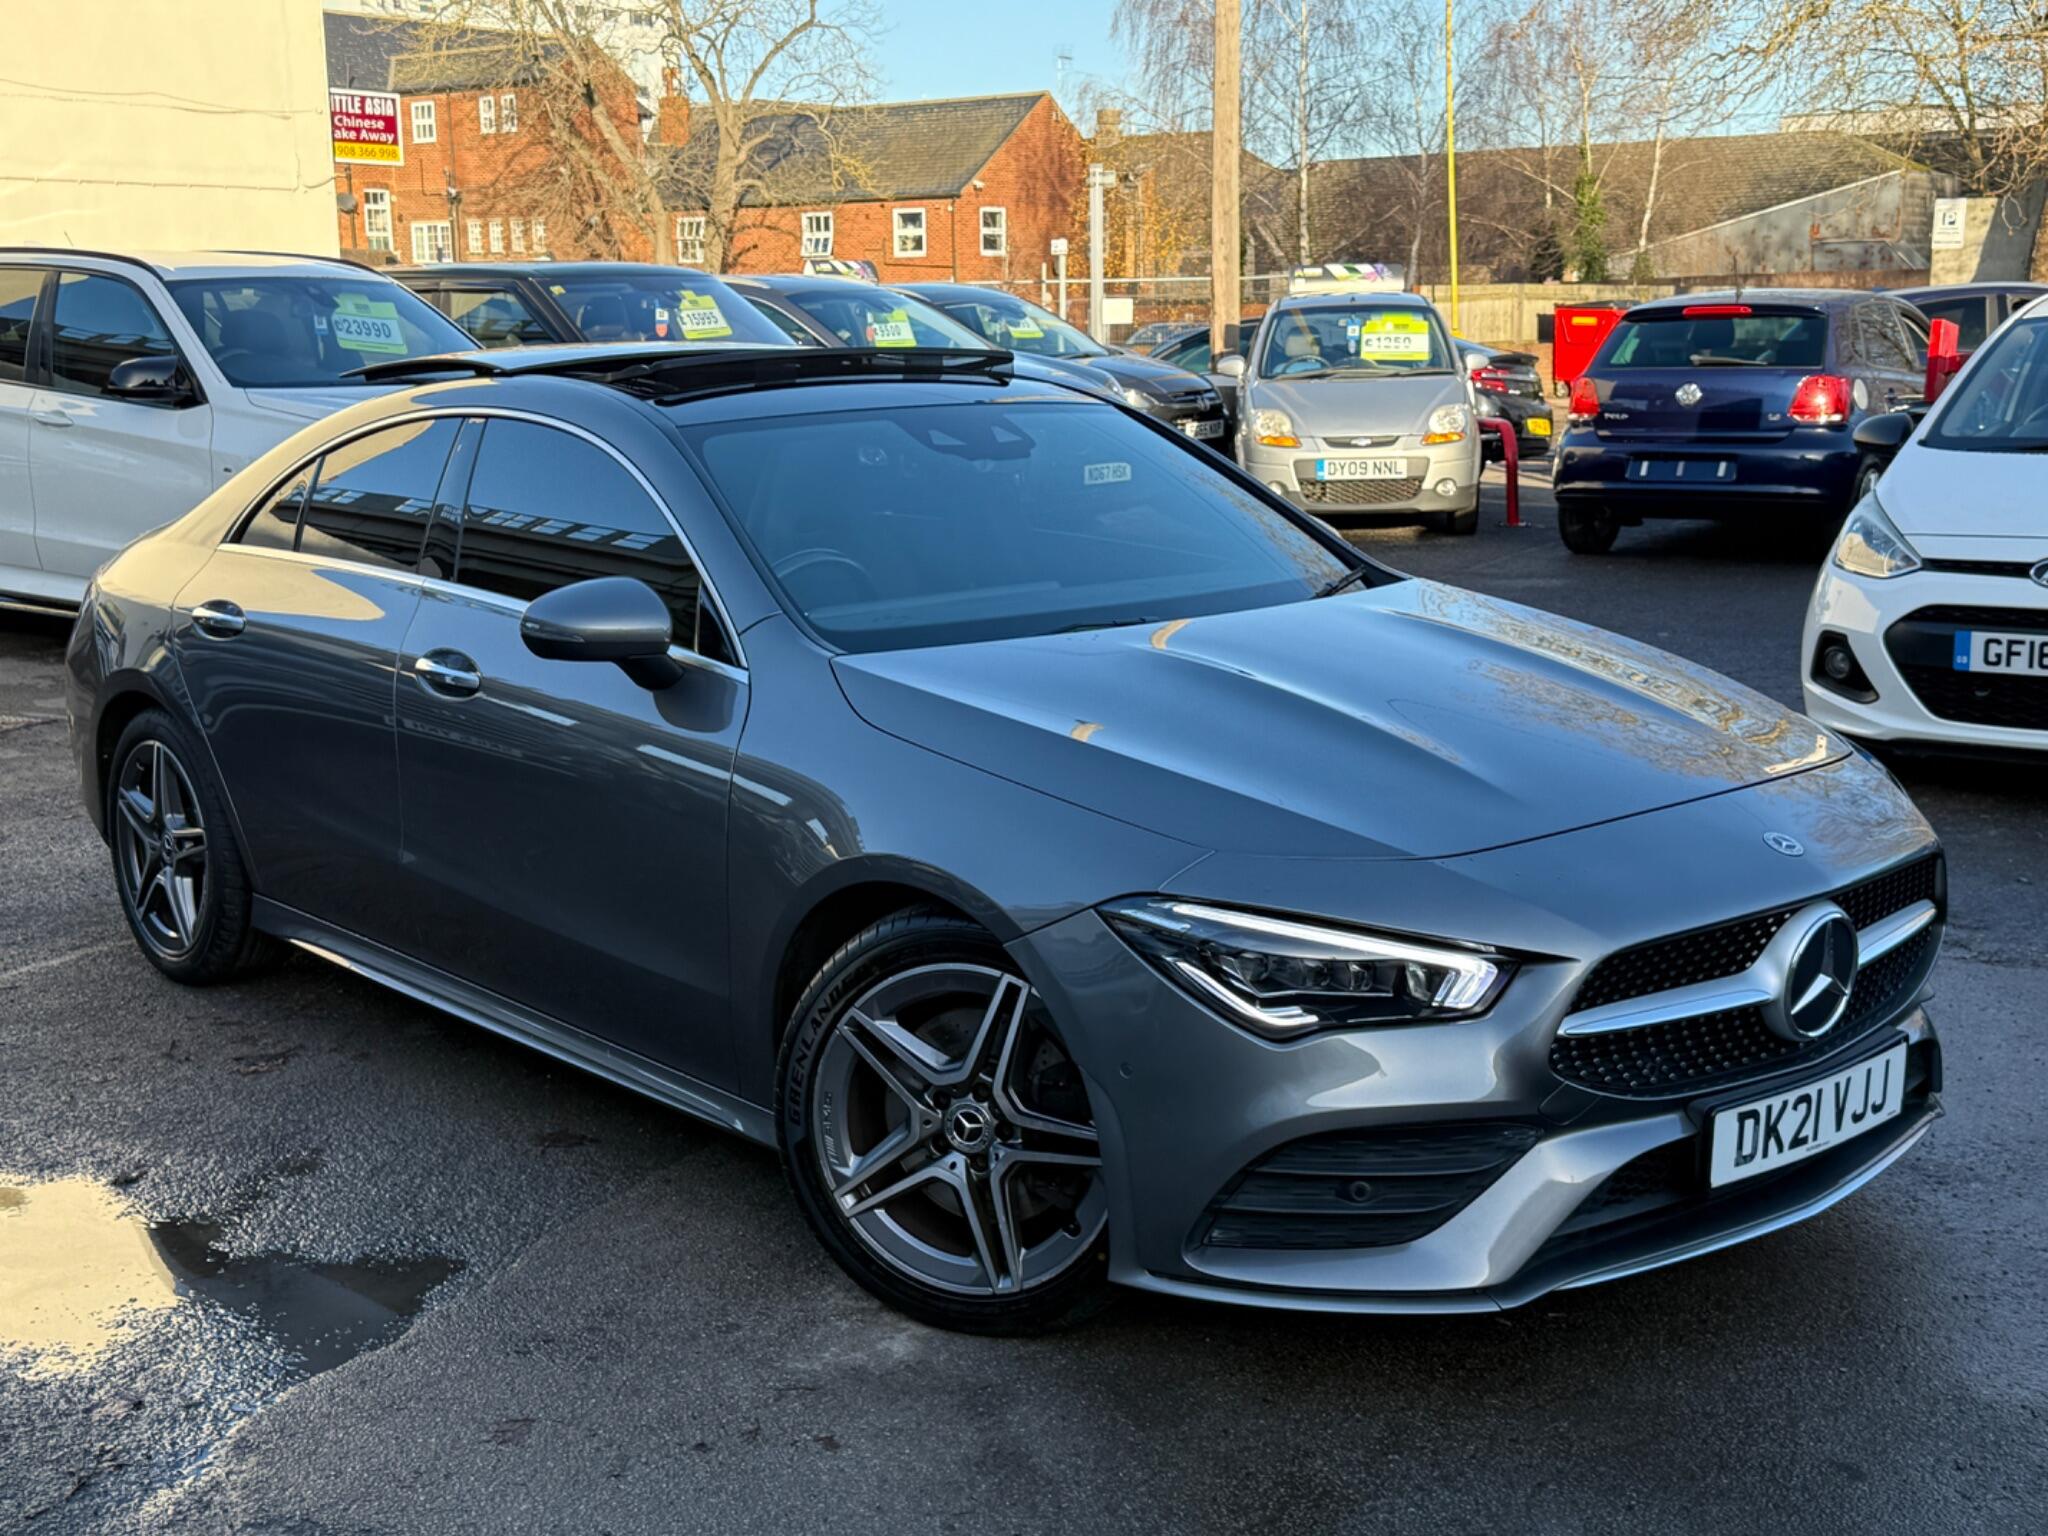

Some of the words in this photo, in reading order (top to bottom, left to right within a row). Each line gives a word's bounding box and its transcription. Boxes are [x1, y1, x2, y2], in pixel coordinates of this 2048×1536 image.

[365, 98, 395, 117] ASIA
[334, 115, 385, 130] Chinese
[333, 128, 357, 139] ake
[360, 130, 394, 144] Away
[1328, 461, 1367, 476] DY09
[1373, 461, 1403, 475] NNL
[1734, 1088, 1823, 1168] DK21
[1834, 1059, 1890, 1133] VJJ
